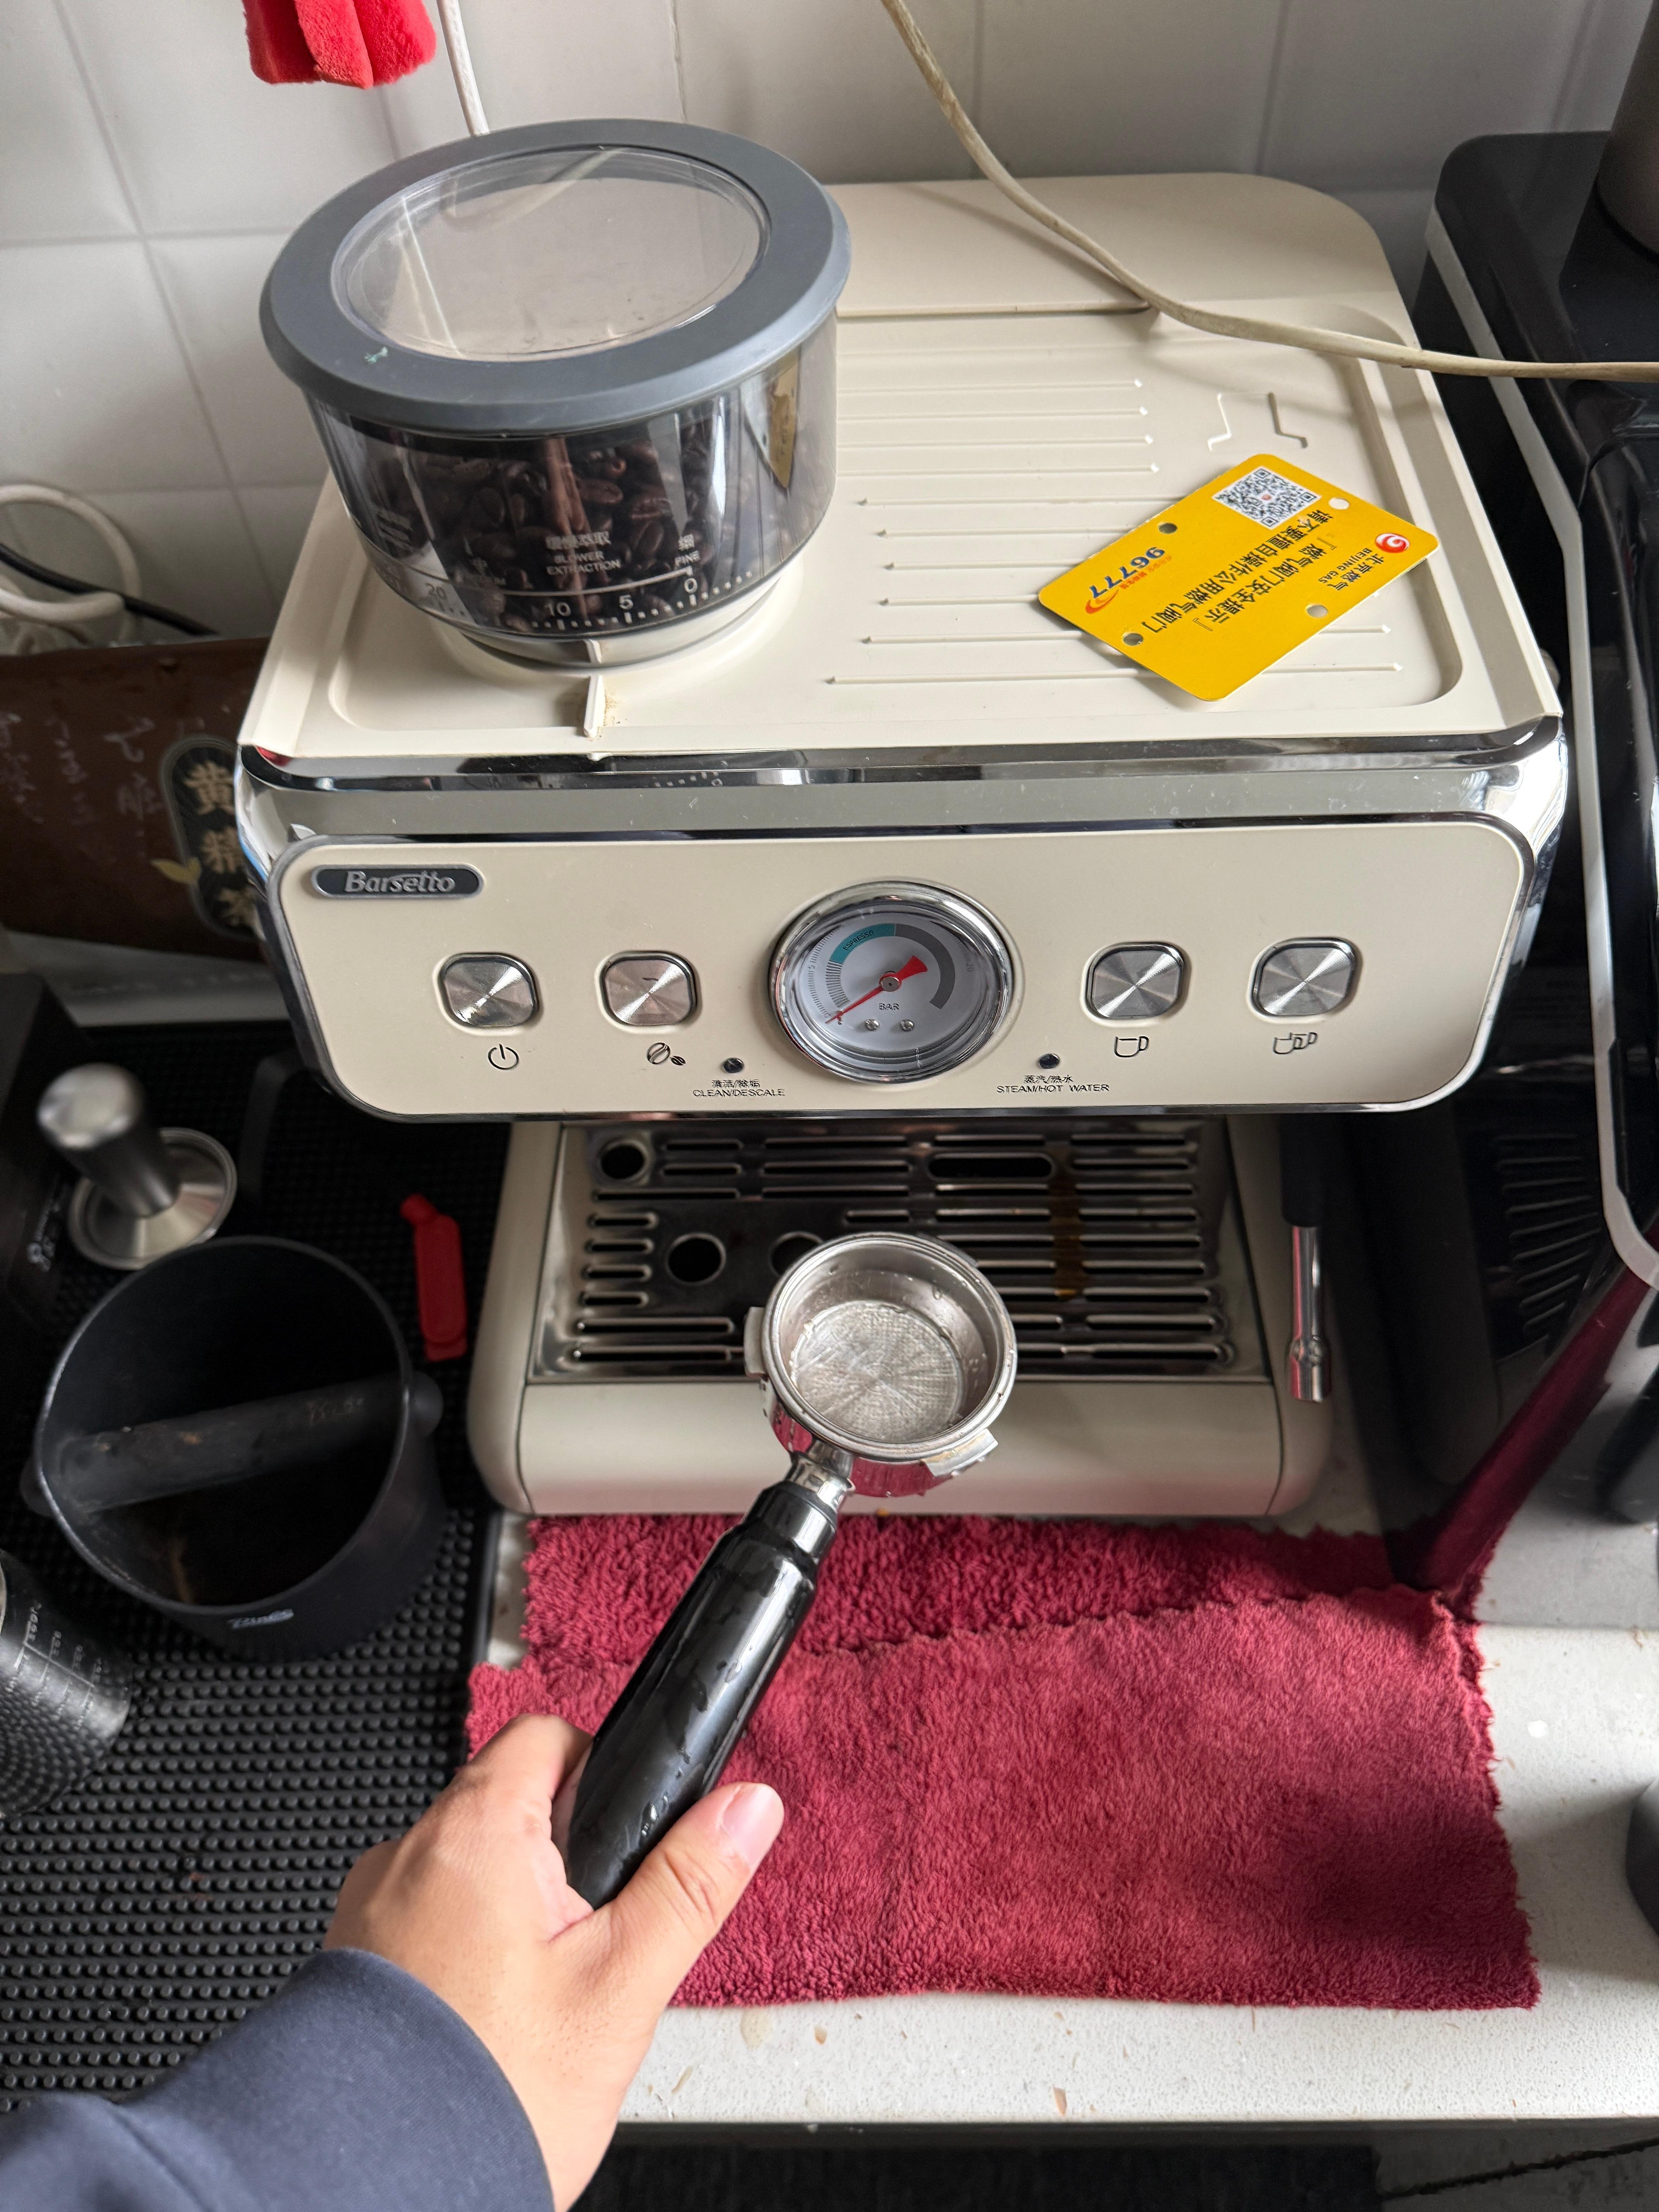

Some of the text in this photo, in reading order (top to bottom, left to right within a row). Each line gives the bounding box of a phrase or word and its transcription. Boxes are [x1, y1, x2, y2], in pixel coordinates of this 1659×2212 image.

[1090, 546, 1166, 598] 96777
[1141, 510, 1334, 634] 请不要擅自操作公用燃气阀门
[1318, 548, 1372, 586] BEIJING GAS
[1327, 553, 1384, 591] 北京燃气
[684, 578, 697, 593] 0
[545, 602, 571, 617] 10
[620, 595, 633, 610] 5
[344, 871, 455, 893] Barsetto
[843, 930, 873, 950] ESPRESSO
[996, 1084, 1109, 1093] STEAM/HOT WATER
